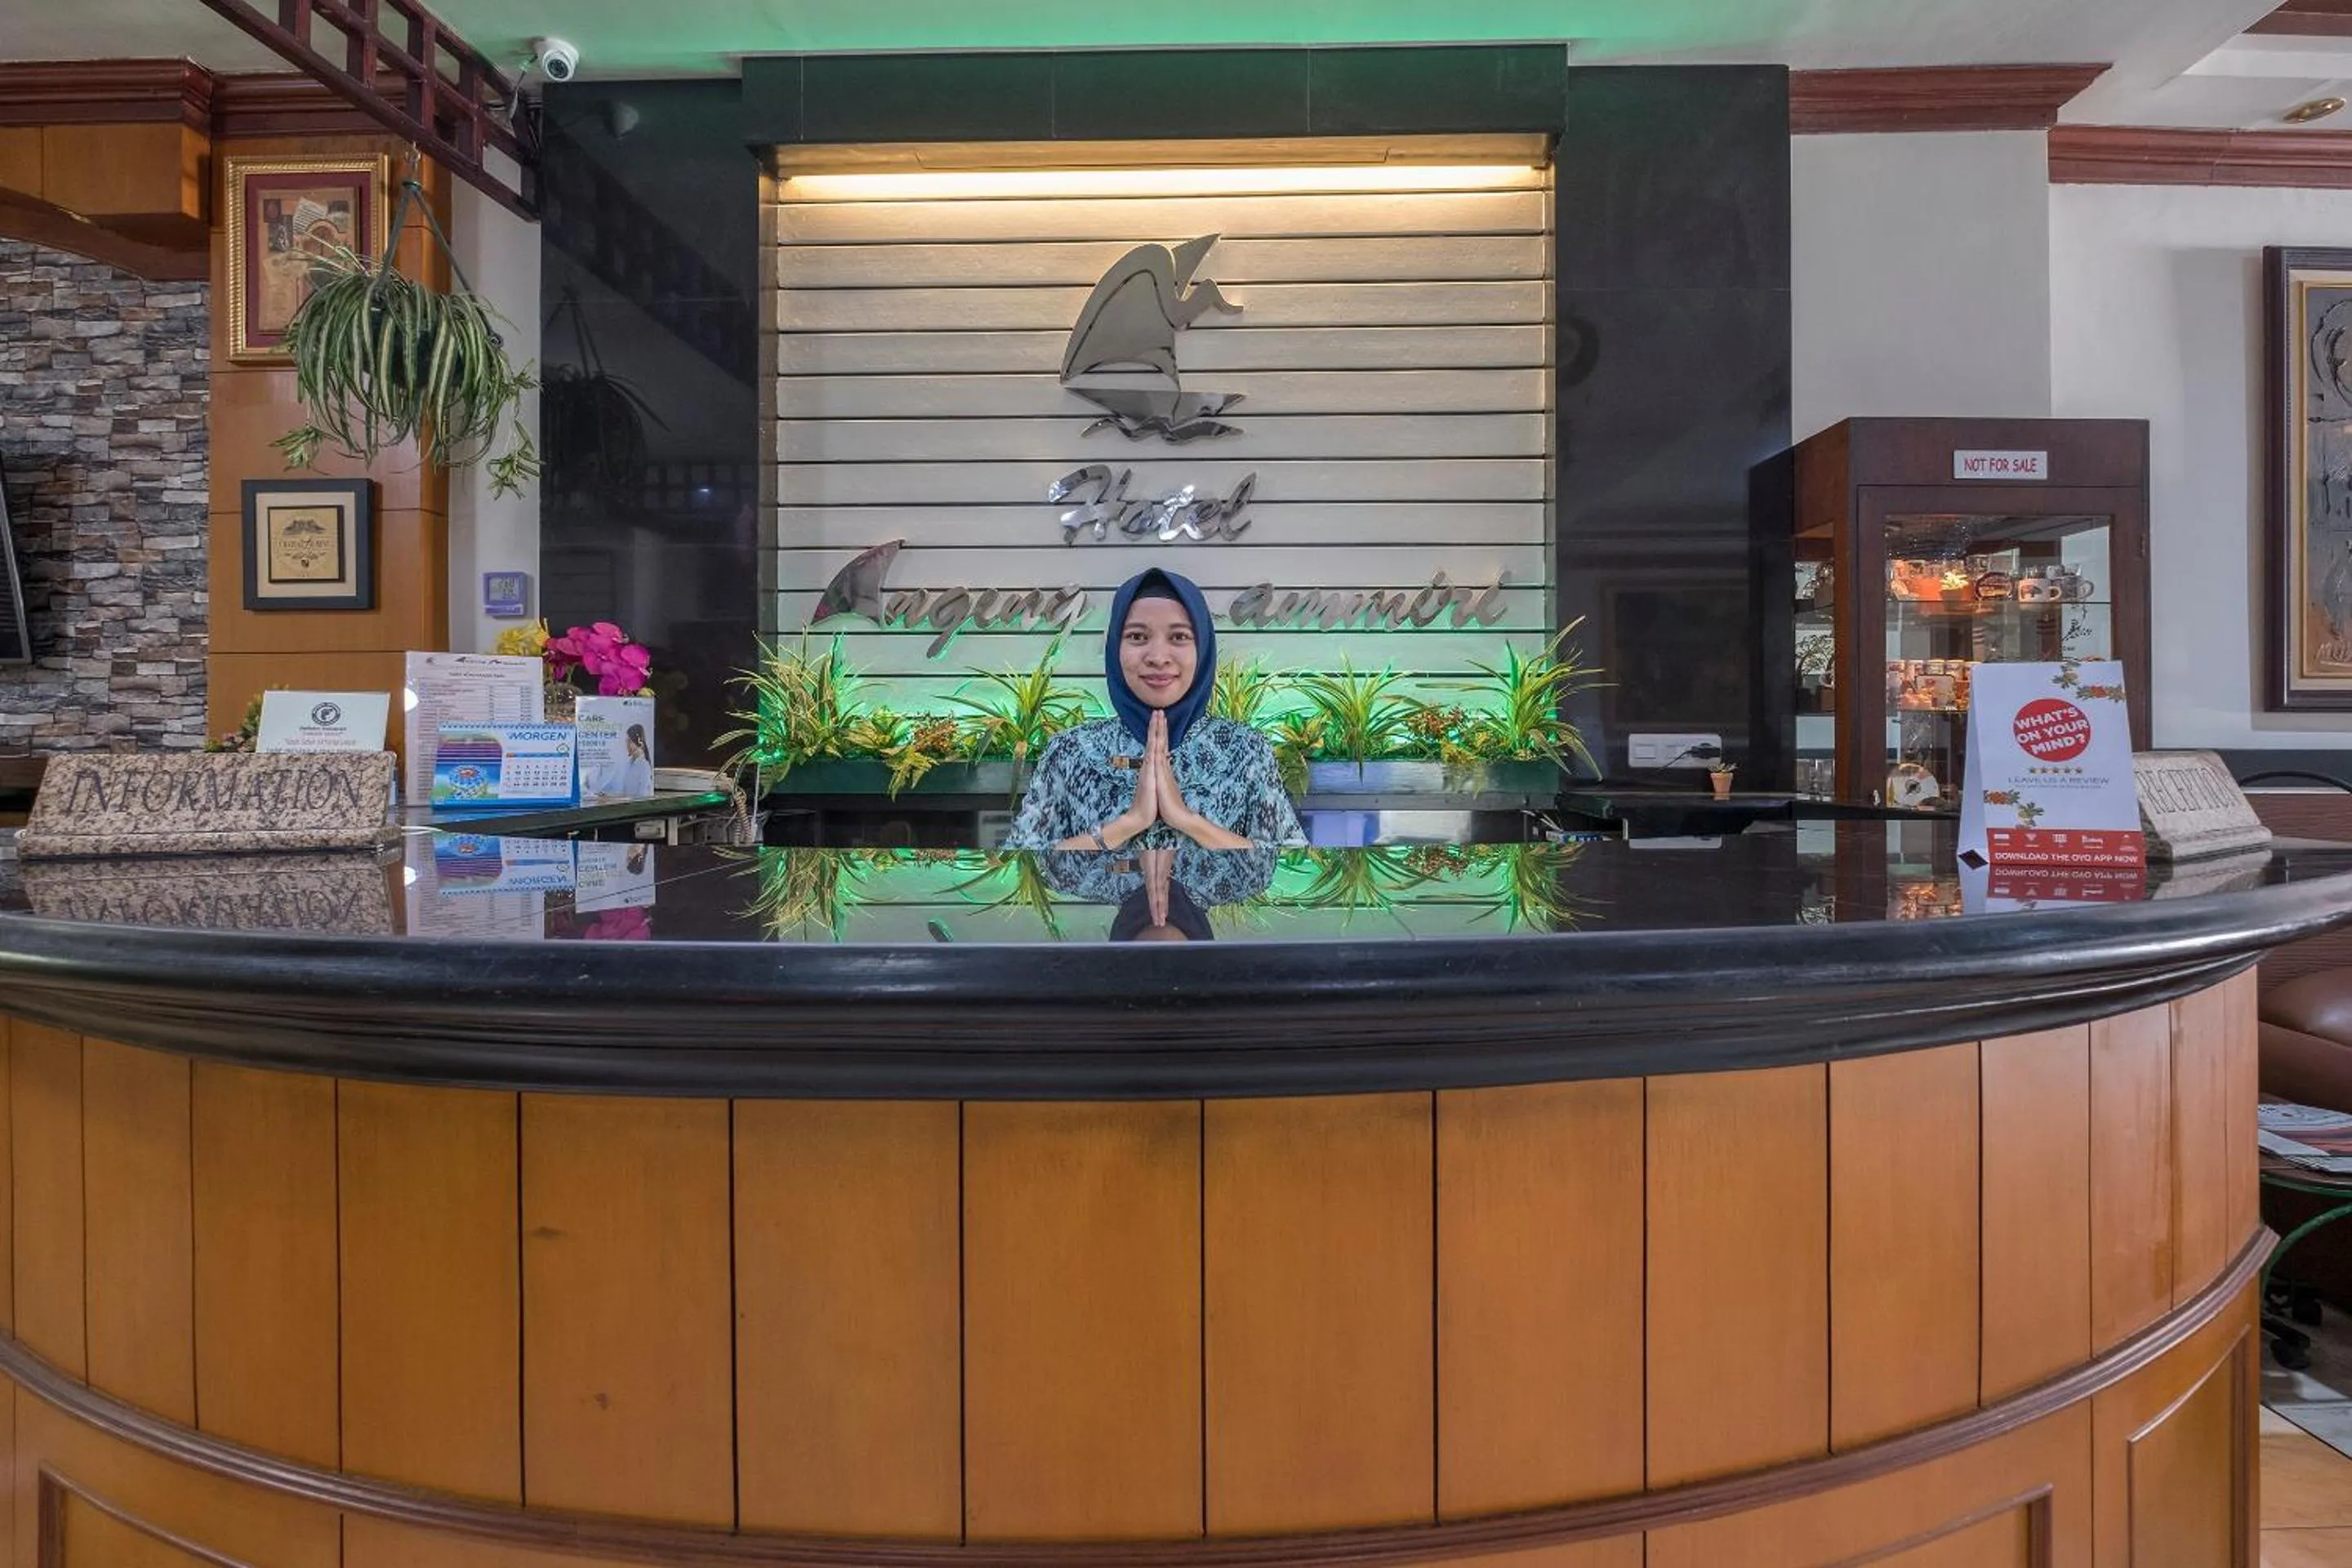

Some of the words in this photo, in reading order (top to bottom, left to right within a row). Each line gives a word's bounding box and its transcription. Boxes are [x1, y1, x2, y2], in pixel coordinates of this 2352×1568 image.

[1963, 457, 1987, 472] NOT
[1989, 457, 2009, 472] FOR
[2012, 457, 2038, 473] SALE
[1049, 464, 1257, 547] Hotel
[1228, 570, 1512, 631] ammiri
[578, 715, 605, 723] CARE
[2015, 706, 2079, 730] WHAT'S
[508, 732, 567, 742] MORGEN
[578, 731, 618, 739] CENTER
[2016, 729, 2042, 744] ON
[2043, 719, 2089, 737] YOUR
[2030, 733, 2086, 755] MIND?
[64, 766, 367, 813] INFORMATION
[2069, 777, 2110, 785] REVIEW
[2133, 767, 2239, 814] RECEPTION
[1994, 852, 2048, 861] DOWNLOAD
[2051, 853, 2069, 862] THE
[2071, 853, 2091, 862] OYO
[2094, 854, 2113, 862] APP
[2114, 855, 2138, 863] NOW
